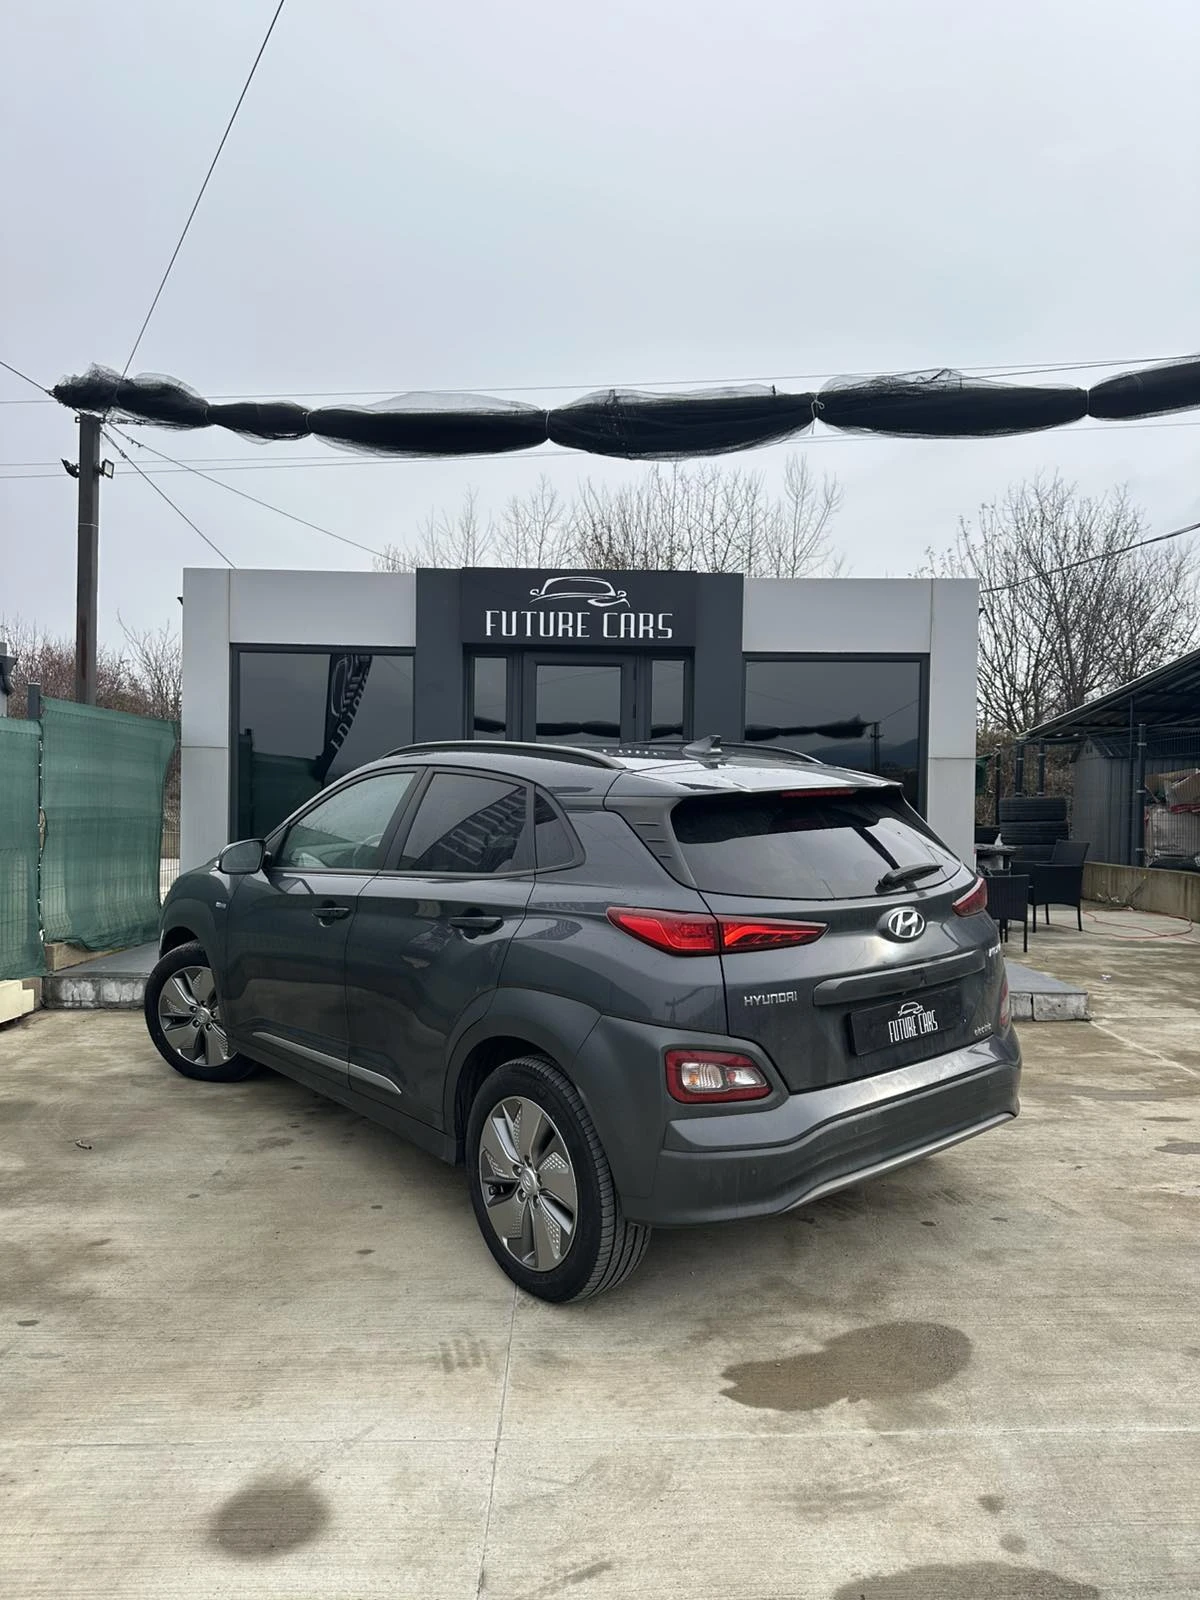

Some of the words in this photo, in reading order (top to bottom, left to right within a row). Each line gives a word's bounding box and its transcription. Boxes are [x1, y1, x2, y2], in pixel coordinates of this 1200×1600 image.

[485, 610, 591, 637] FUTURE
[602, 612, 673, 639] CARS
[743, 990, 798, 1006] HYUNDAI
[888, 1015, 918, 1043] FUTURE
[918, 1009, 938, 1034] CARS
